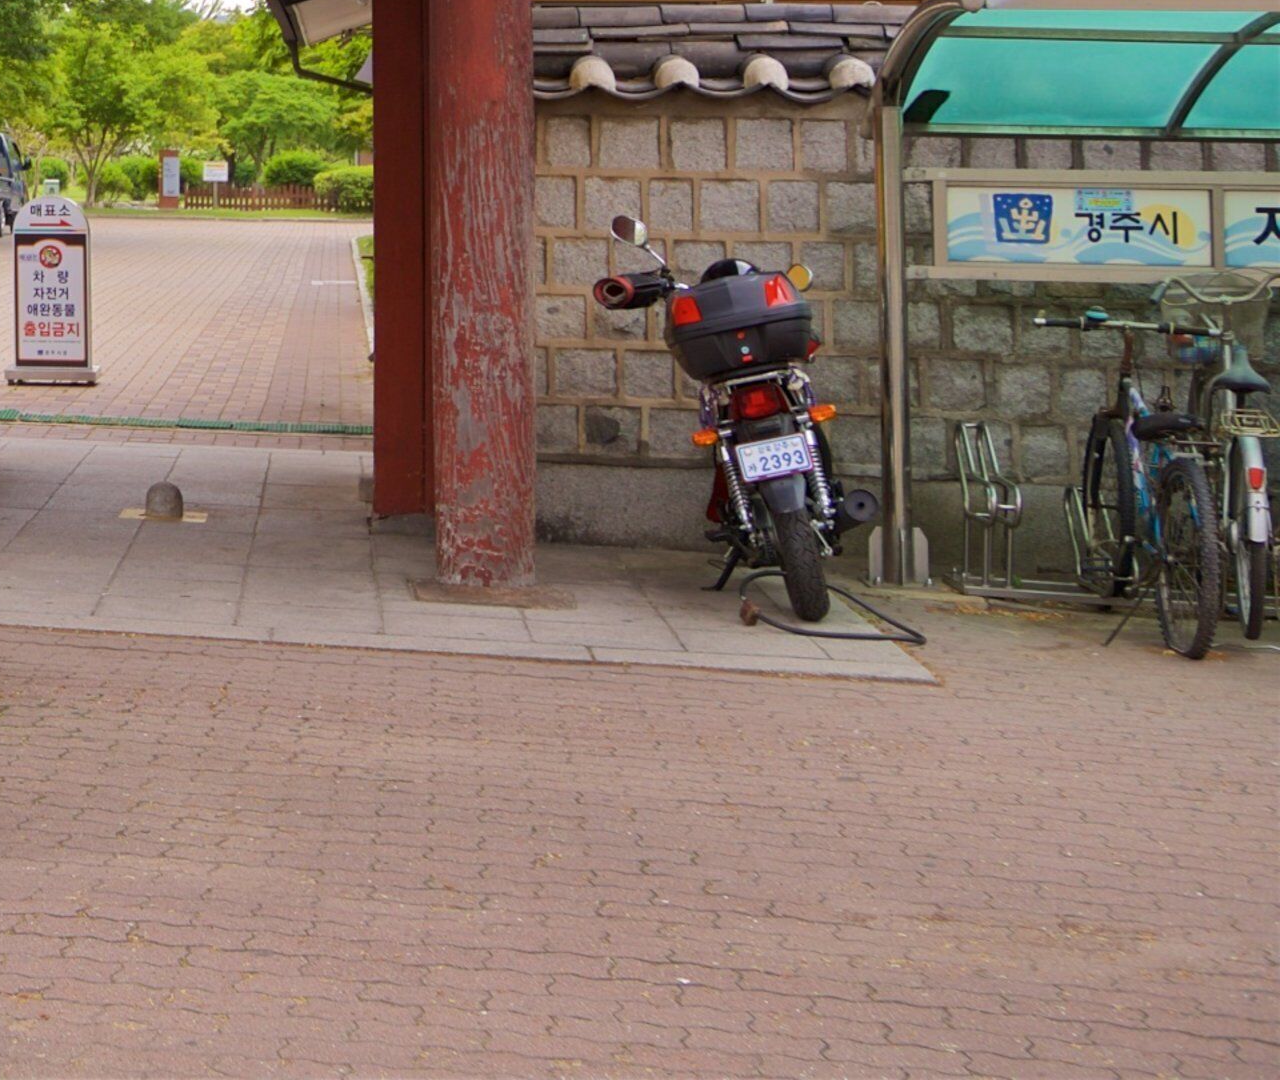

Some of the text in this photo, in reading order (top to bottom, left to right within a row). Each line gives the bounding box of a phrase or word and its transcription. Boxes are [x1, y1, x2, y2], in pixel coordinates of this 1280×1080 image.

[30, 204, 71, 217] 매표소
[1074, 211, 1179, 245] 경주시
[33, 287, 69, 300] 자전거
[27, 303, 75, 317] 애완동물
[24, 321, 80, 337] 출입금지
[759, 450, 804, 472] 2393
